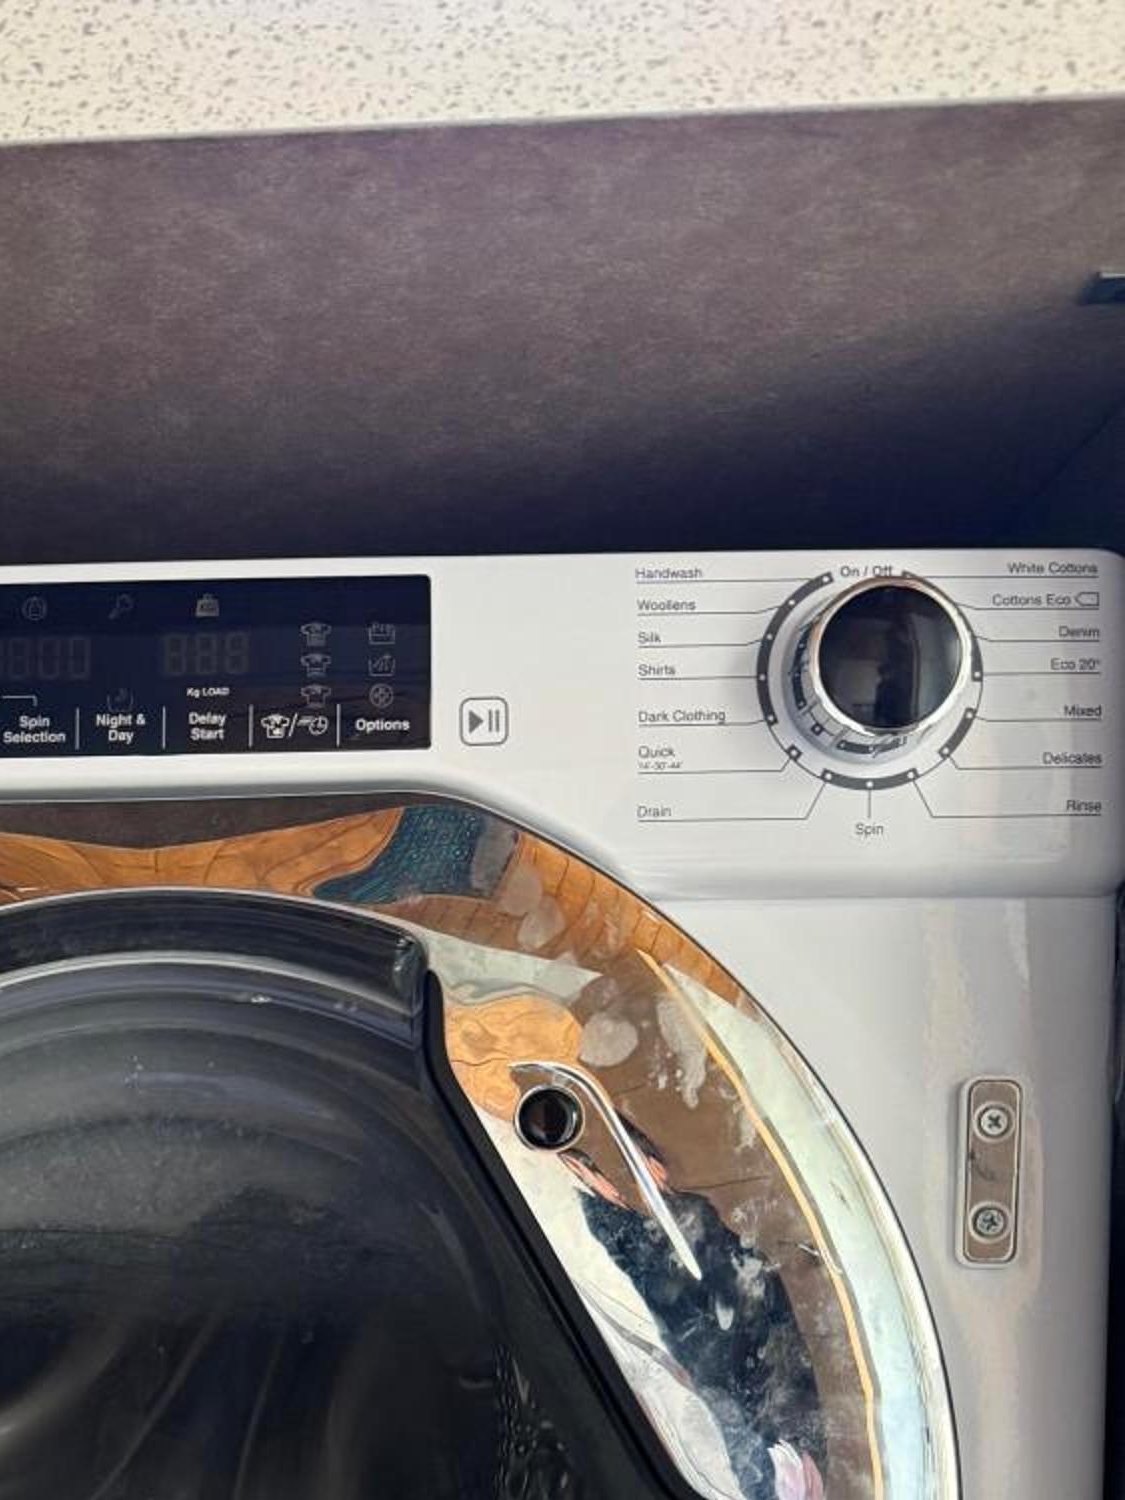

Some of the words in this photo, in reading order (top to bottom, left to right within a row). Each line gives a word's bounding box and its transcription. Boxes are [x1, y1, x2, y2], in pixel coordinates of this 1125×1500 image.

[635, 568, 703, 579] Handwash
[840, 565, 860, 577] On
[1007, 562, 1045, 574] White
[1048, 561, 1098, 574] Cottons
[637, 599, 696, 611] Woollens
[992, 594, 1042, 606] Cottons
[1046, 595, 1071, 606] Eco
[638, 632, 662, 643] Silk
[1058, 625, 1100, 638] Denim
[1050, 659, 1076, 670] Eco
[638, 665, 676, 677] Shirts
[202, 686, 230, 697] LOAD
[1064, 705, 1102, 717] Mixed
[18, 715, 51, 730] Spin
[95, 713, 132, 728] Night
[135, 713, 146, 726] &
[188, 711, 227, 727] Delay
[638, 711, 668, 723] Dark
[672, 710, 726, 726] Clothing
[355, 718, 411, 733] Options
[2, 731, 67, 744] Selection
[107, 729, 135, 745] Day
[190, 727, 225, 741] Start
[638, 745, 676, 758] Quick
[1043, 752, 1103, 764] Delicates
[637, 806, 672, 817] Drain
[1066, 800, 1103, 812] Rinse
[855, 823, 885, 837] Spin
